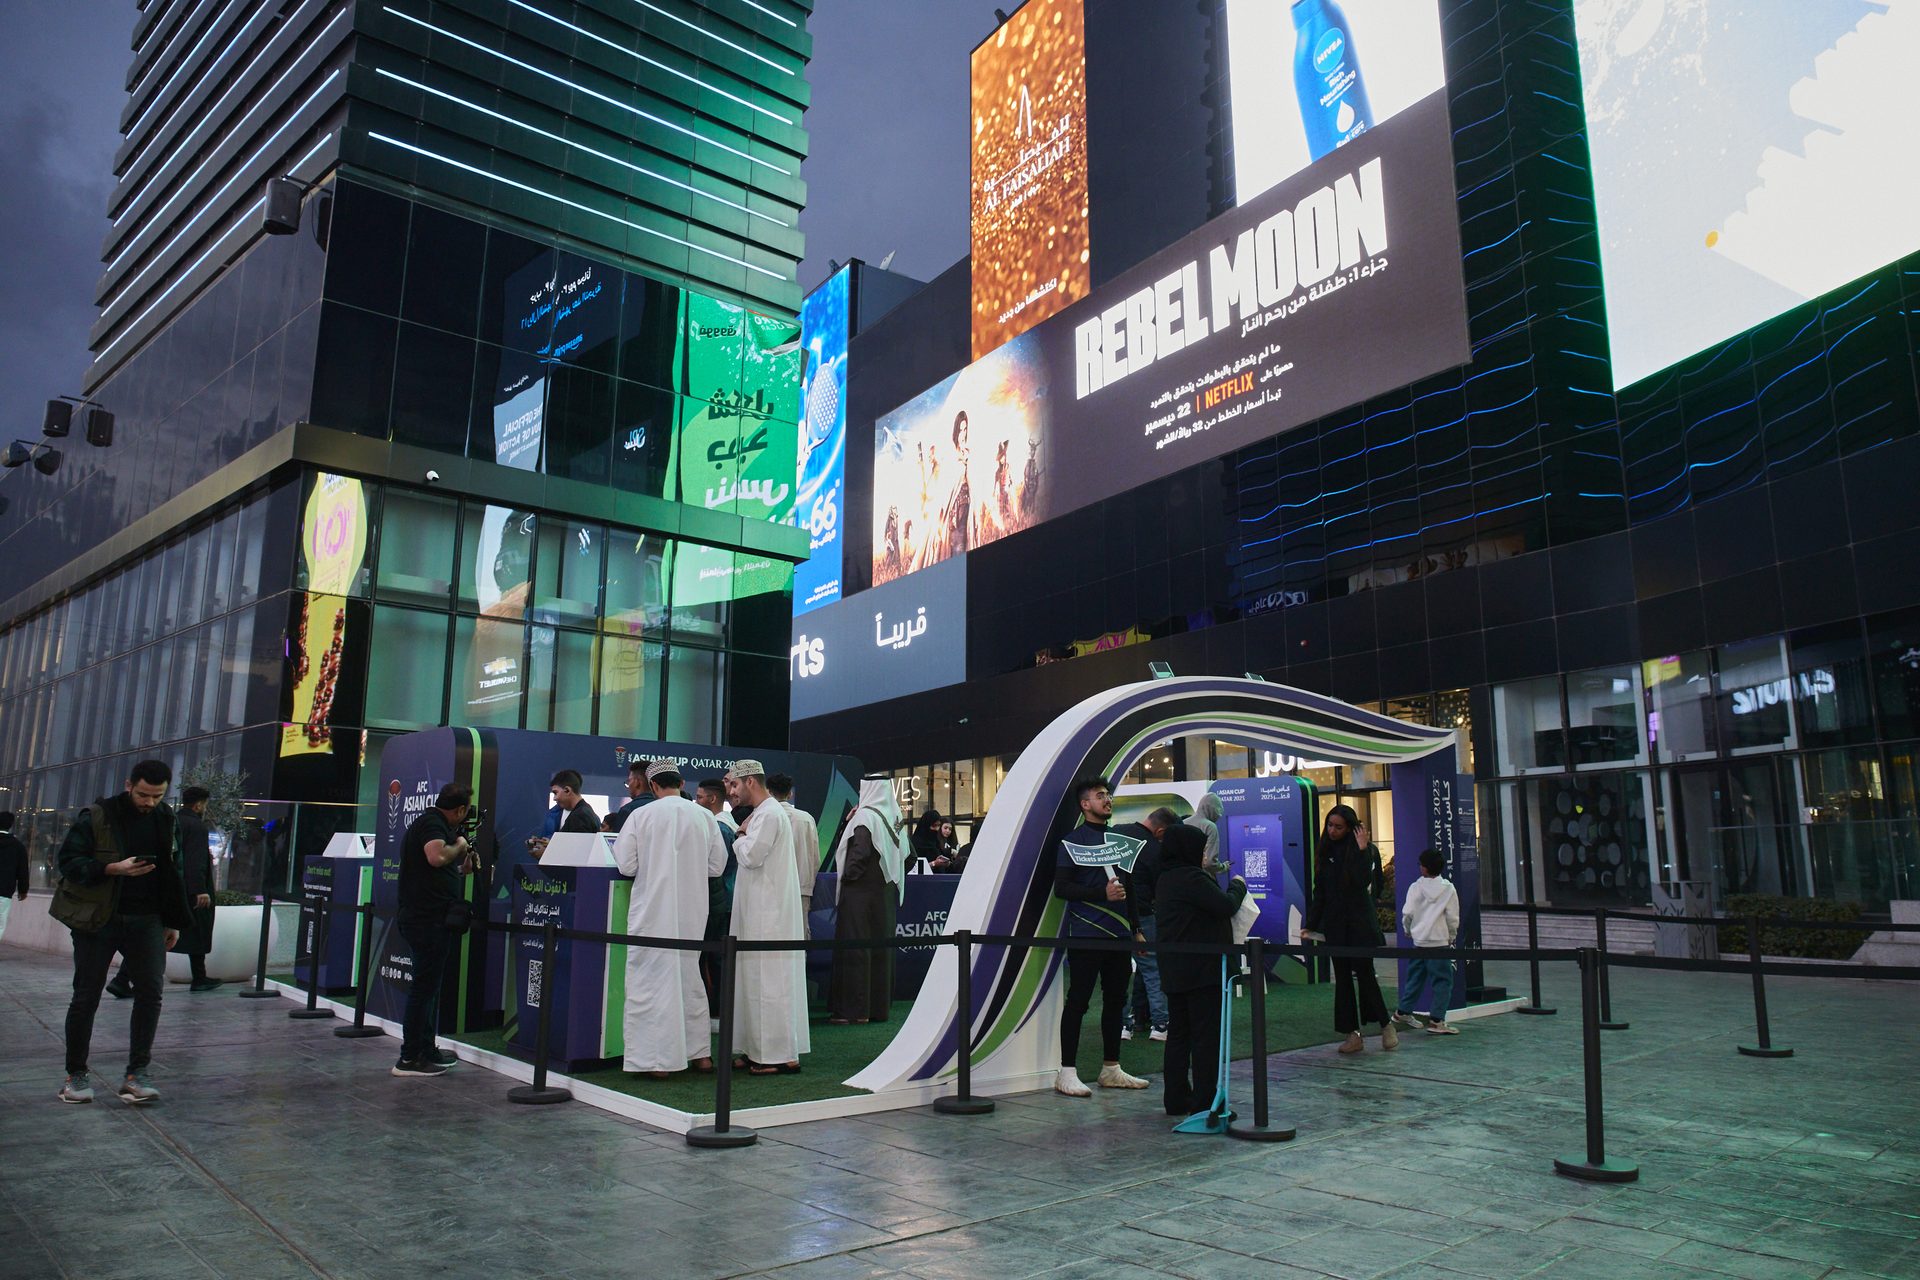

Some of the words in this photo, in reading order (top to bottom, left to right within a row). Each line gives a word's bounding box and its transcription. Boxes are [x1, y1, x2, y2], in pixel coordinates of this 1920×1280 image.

[1317, 38, 1342, 64] NIVEA
[1360, 257, 1388, 277] جزء
[1075, 260, 1209, 400] REBEL
[1209, 156, 1388, 333] MOON
[1309, 275, 1347, 301] طفلة
[1288, 295, 1307, 314] من
[1264, 304, 1287, 327] رحم
[1241, 313, 1263, 338] النار
[1258, 346, 1269, 365] لم
[1270, 343, 1281, 354] ما
[1233, 353, 1257, 373] يتحقق
[1196, 364, 1232, 387] بالبطولات
[1173, 382, 1195, 400] يتحقق
[1205, 371, 1254, 409] NETFLIX
[1266, 388, 1282, 402] تبدأ
[1150, 391, 1173, 409] بالتمرد
[1243, 391, 1265, 415] أسعار
[1177, 402, 1191, 419] 22
[1218, 403, 1242, 423] الخطط
[1145, 412, 1176, 435] ديسمبر
[1192, 420, 1203, 433] 32
[1203, 418, 1216, 430] من
[691, 757, 722, 769] QATAR
[416, 781, 428, 793] AFC
[403, 795, 425, 812] ASIAN
[1433, 778, 1441, 816] 2023
[1097, 853, 1122, 862] available
[1121, 849, 1133, 858] here
[925, 911, 947, 921] AFC
[895, 923, 944, 937] ASIAN
